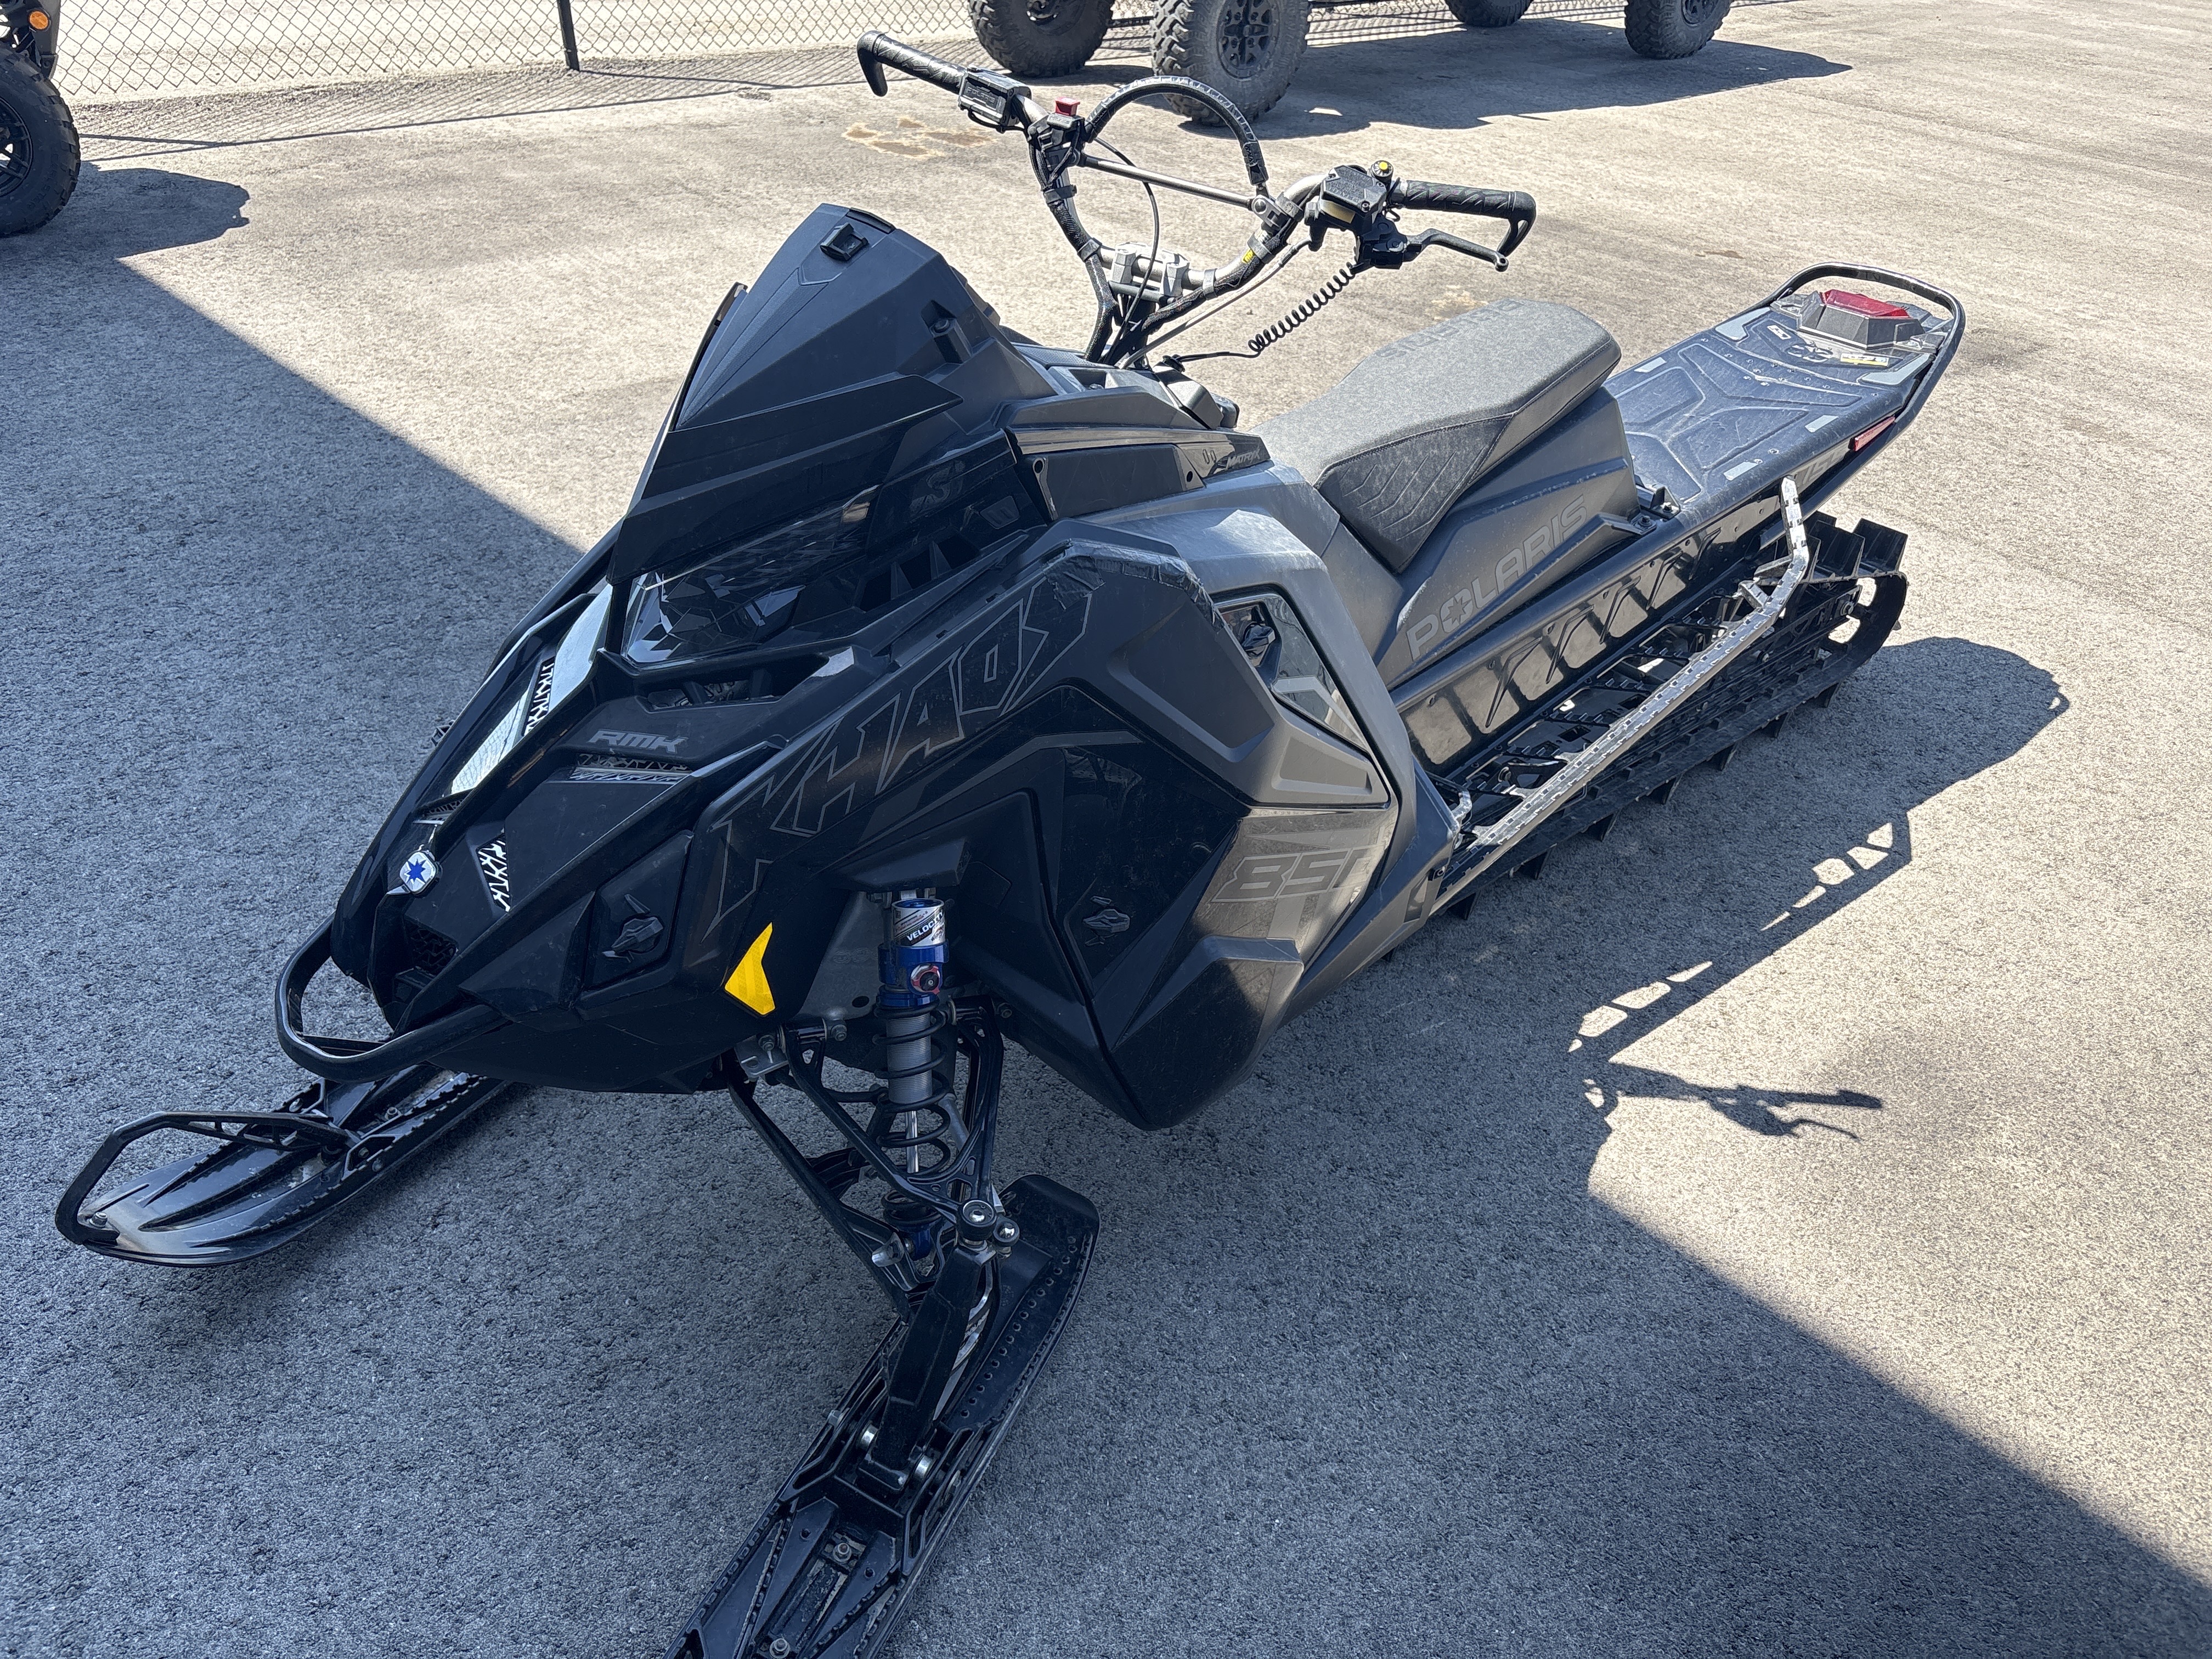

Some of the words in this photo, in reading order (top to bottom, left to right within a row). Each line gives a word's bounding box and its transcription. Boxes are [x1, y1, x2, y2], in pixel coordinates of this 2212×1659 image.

[1225, 445, 1261, 470] MATRYX
[1406, 494, 1588, 661] POLARIS
[588, 729, 689, 754] RMK
[1211, 843, 1385, 903] 850
[906, 910, 943, 941] VELOCITY
